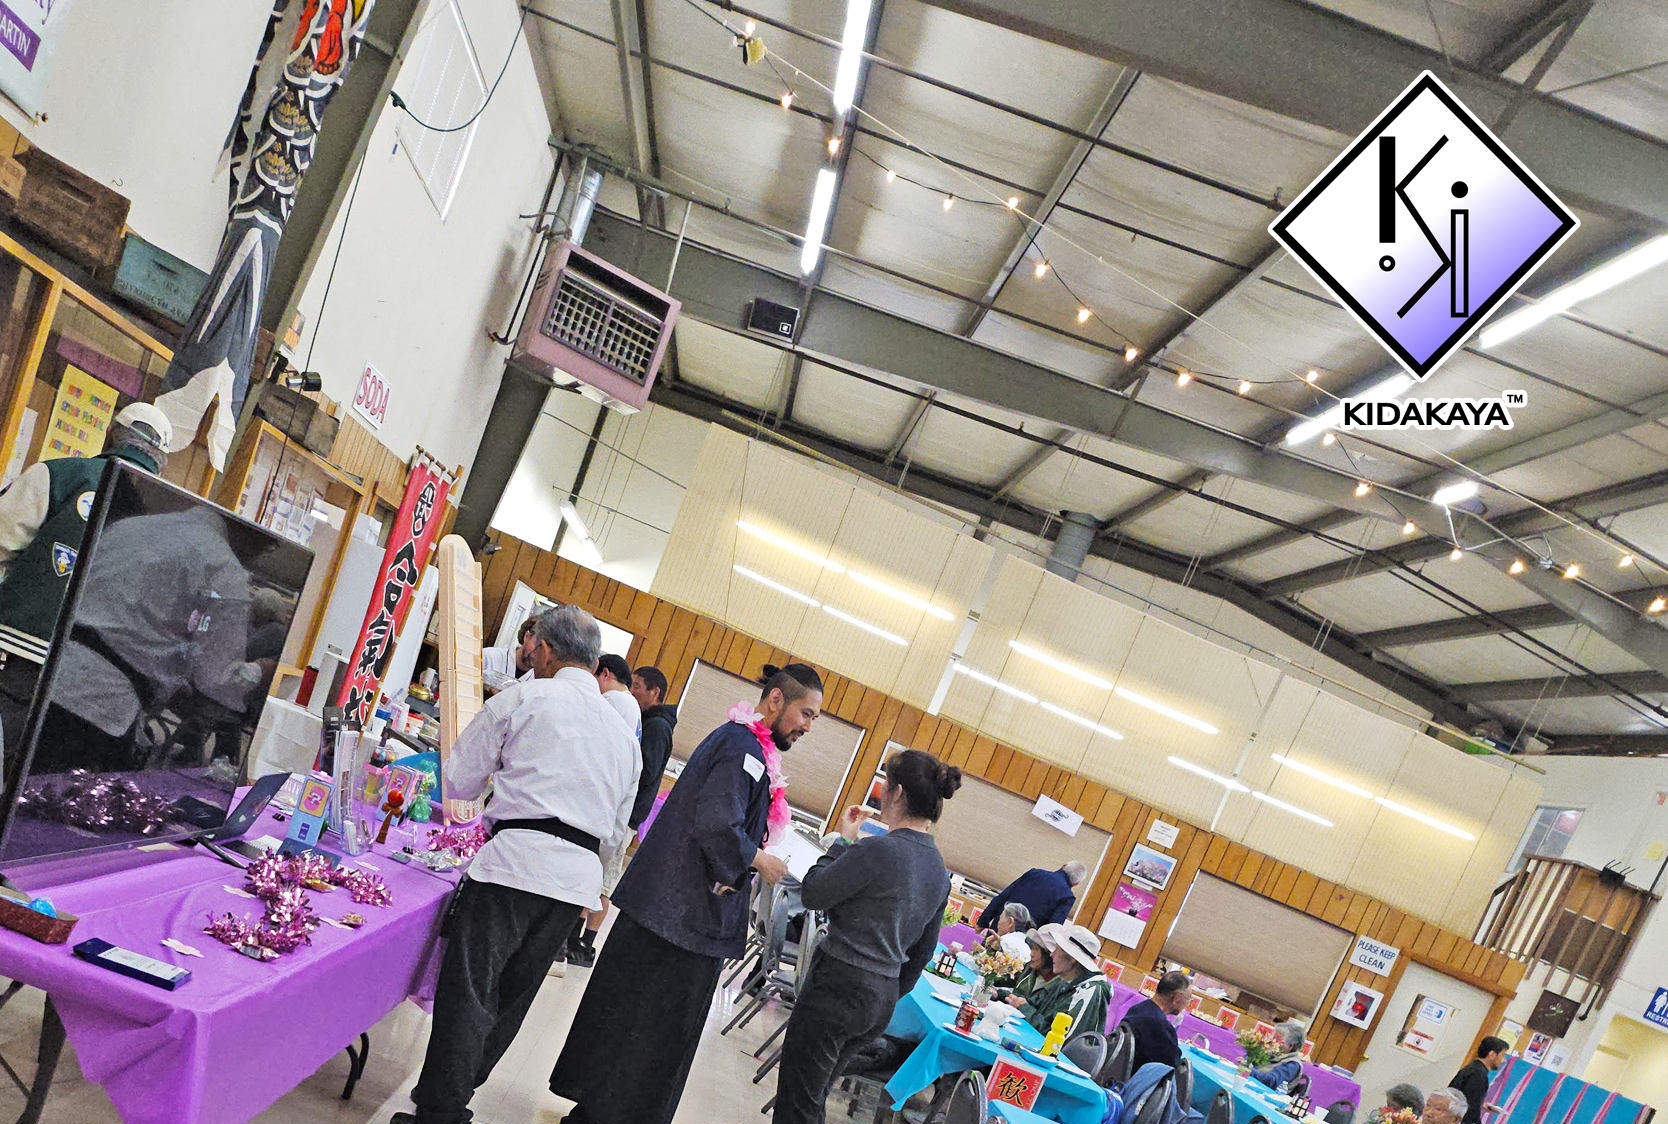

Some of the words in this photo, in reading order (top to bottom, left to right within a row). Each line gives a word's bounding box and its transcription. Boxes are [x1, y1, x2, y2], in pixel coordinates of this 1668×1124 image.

[356, 367, 390, 424] SODA
[198, 614, 211, 632] LG
[1358, 940, 1379, 955] PLEASE
[1380, 948, 1396, 960] KEEP
[1359, 954, 1385, 970] CLEAN
[1646, 1011, 1668, 1027] RESTR
